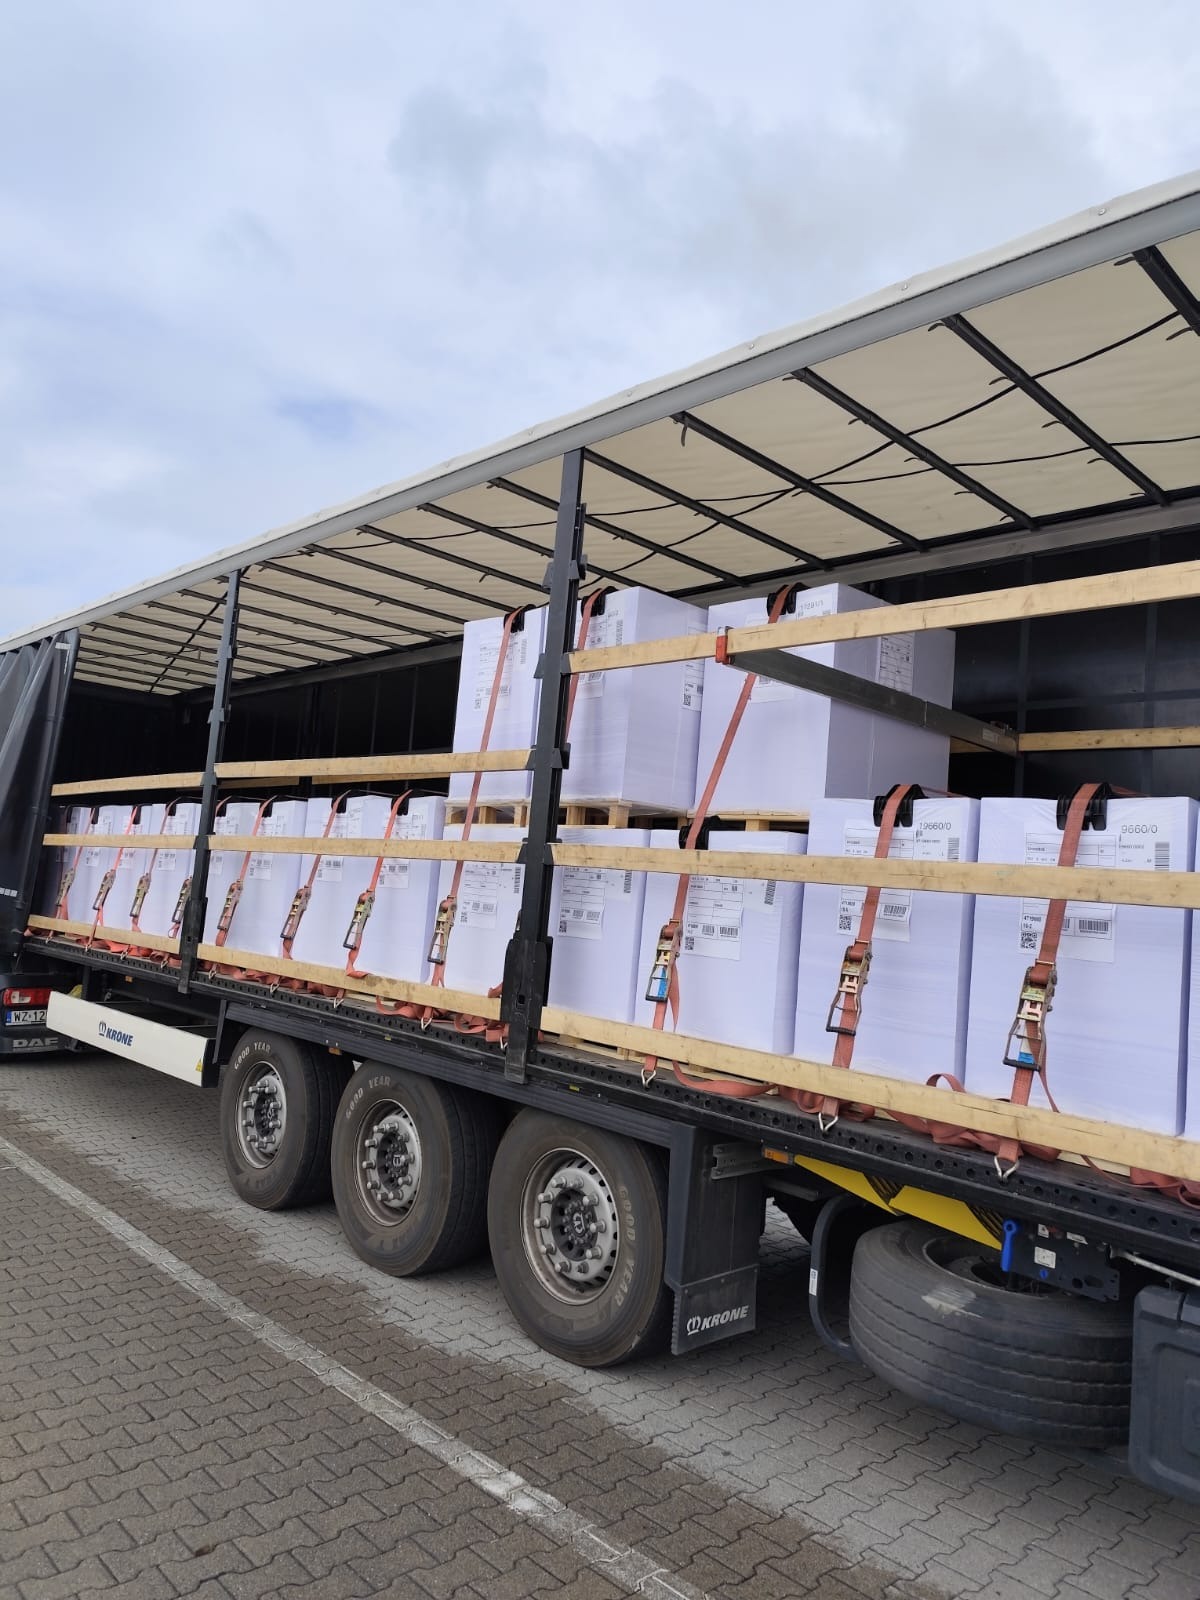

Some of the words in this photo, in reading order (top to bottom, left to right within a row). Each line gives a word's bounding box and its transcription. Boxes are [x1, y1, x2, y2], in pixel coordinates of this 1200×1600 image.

[13, 1037, 59, 1047] DAF
[106, 1027, 134, 1046] KRONE
[234, 1046, 250, 1070] GOOD
[254, 1041, 271, 1053] YEAR
[345, 1087, 364, 1119] GOOD
[368, 1075, 391, 1088] YEAR
[619, 1185, 636, 1241] GOOD
[615, 1259, 635, 1307] YEAR
[700, 1304, 749, 1331] KRONE
